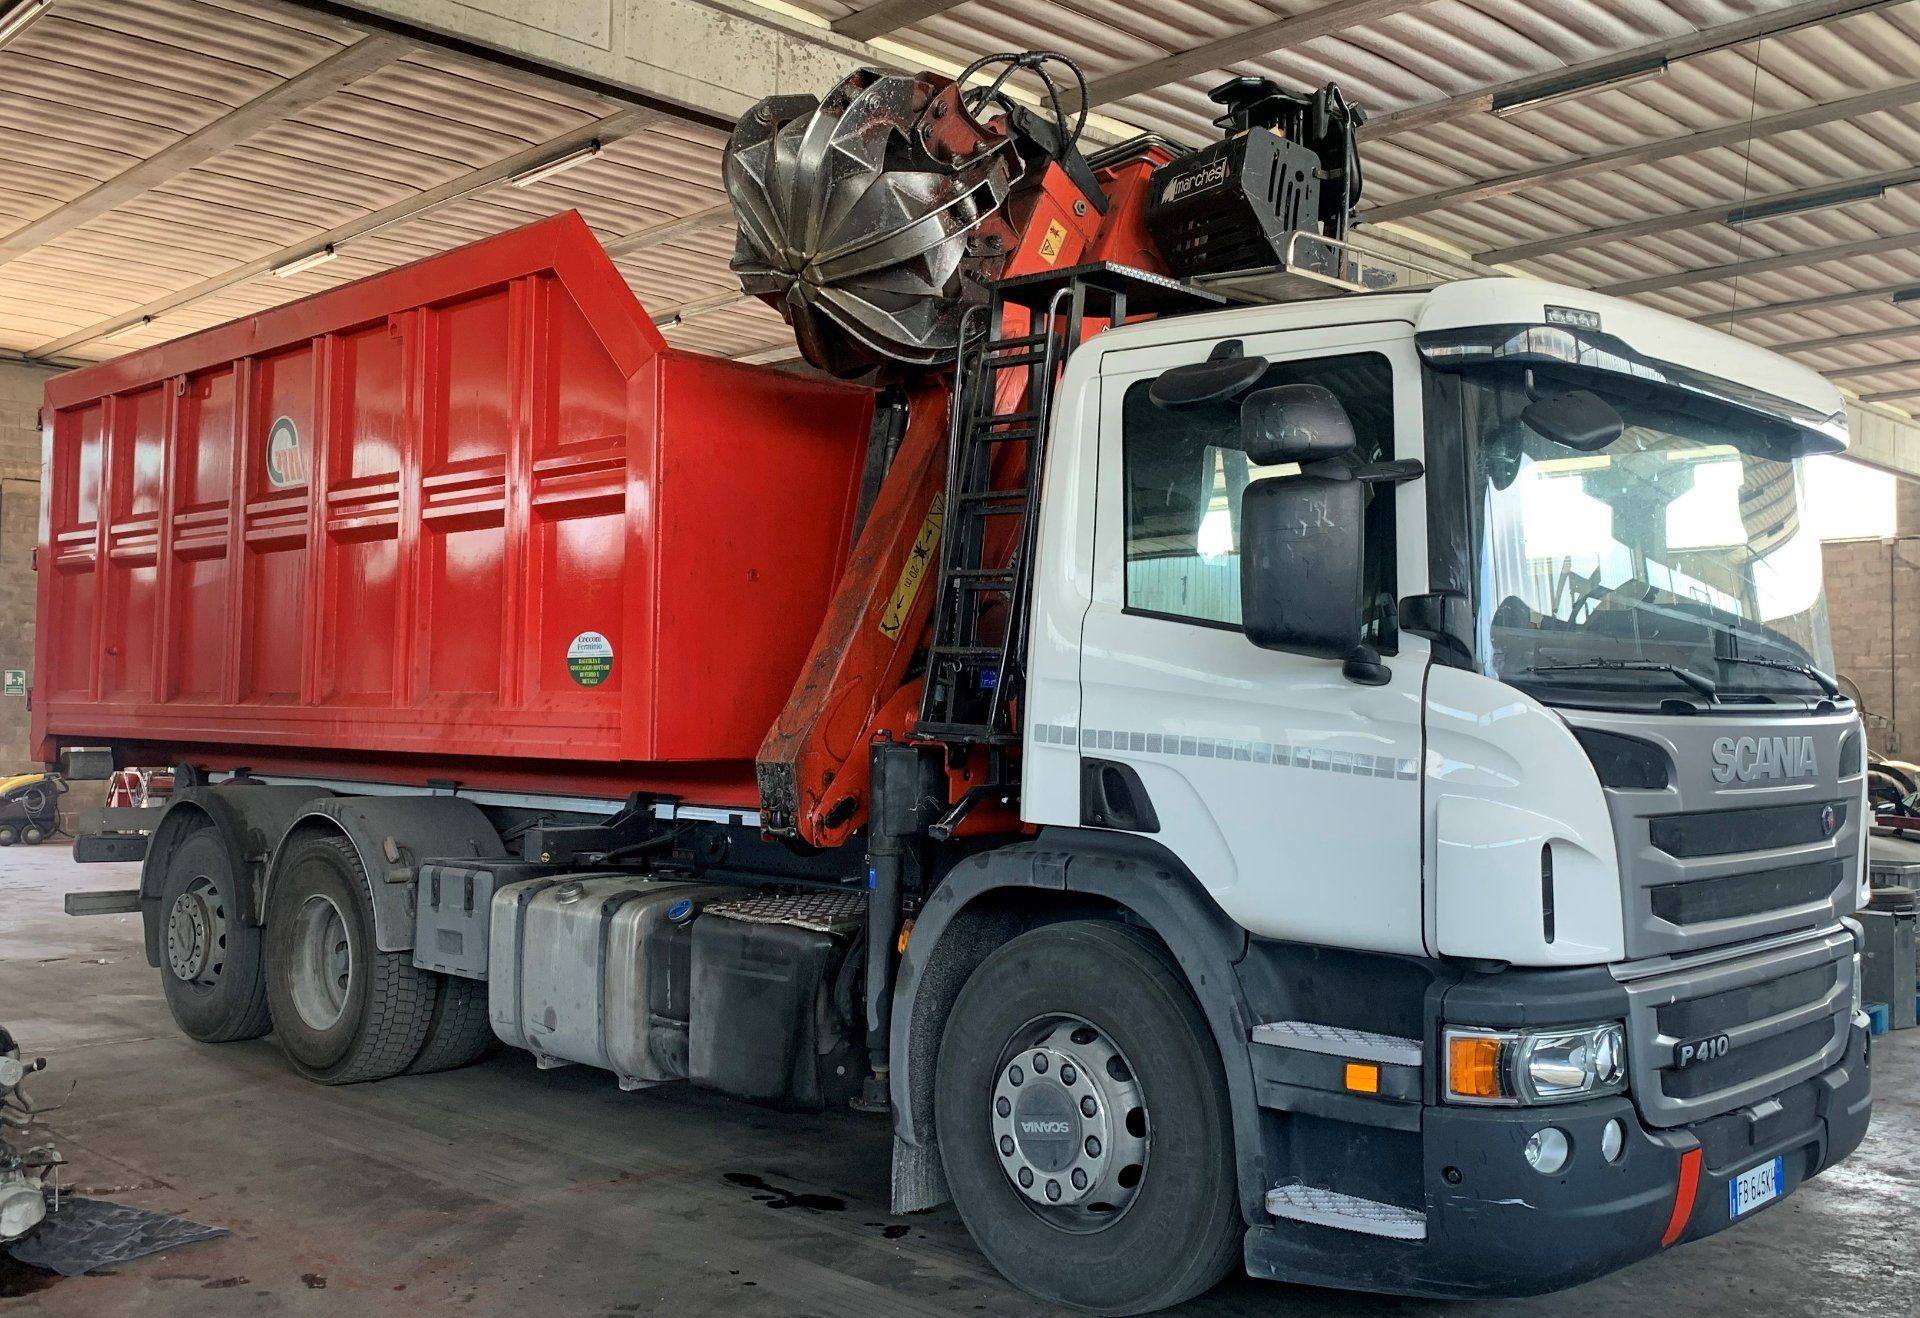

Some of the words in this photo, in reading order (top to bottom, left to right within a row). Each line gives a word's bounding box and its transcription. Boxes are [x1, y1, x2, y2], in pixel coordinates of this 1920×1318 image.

[908, 565, 920, 578] 20
[904, 578, 912, 588] m
[1712, 736, 1819, 783] SCANIA
[1681, 1046, 1693, 1067] P
[1696, 1036, 1729, 1061] 410
[1021, 1121, 1069, 1133] SCANIA
[1738, 1180, 1748, 1206] FB
